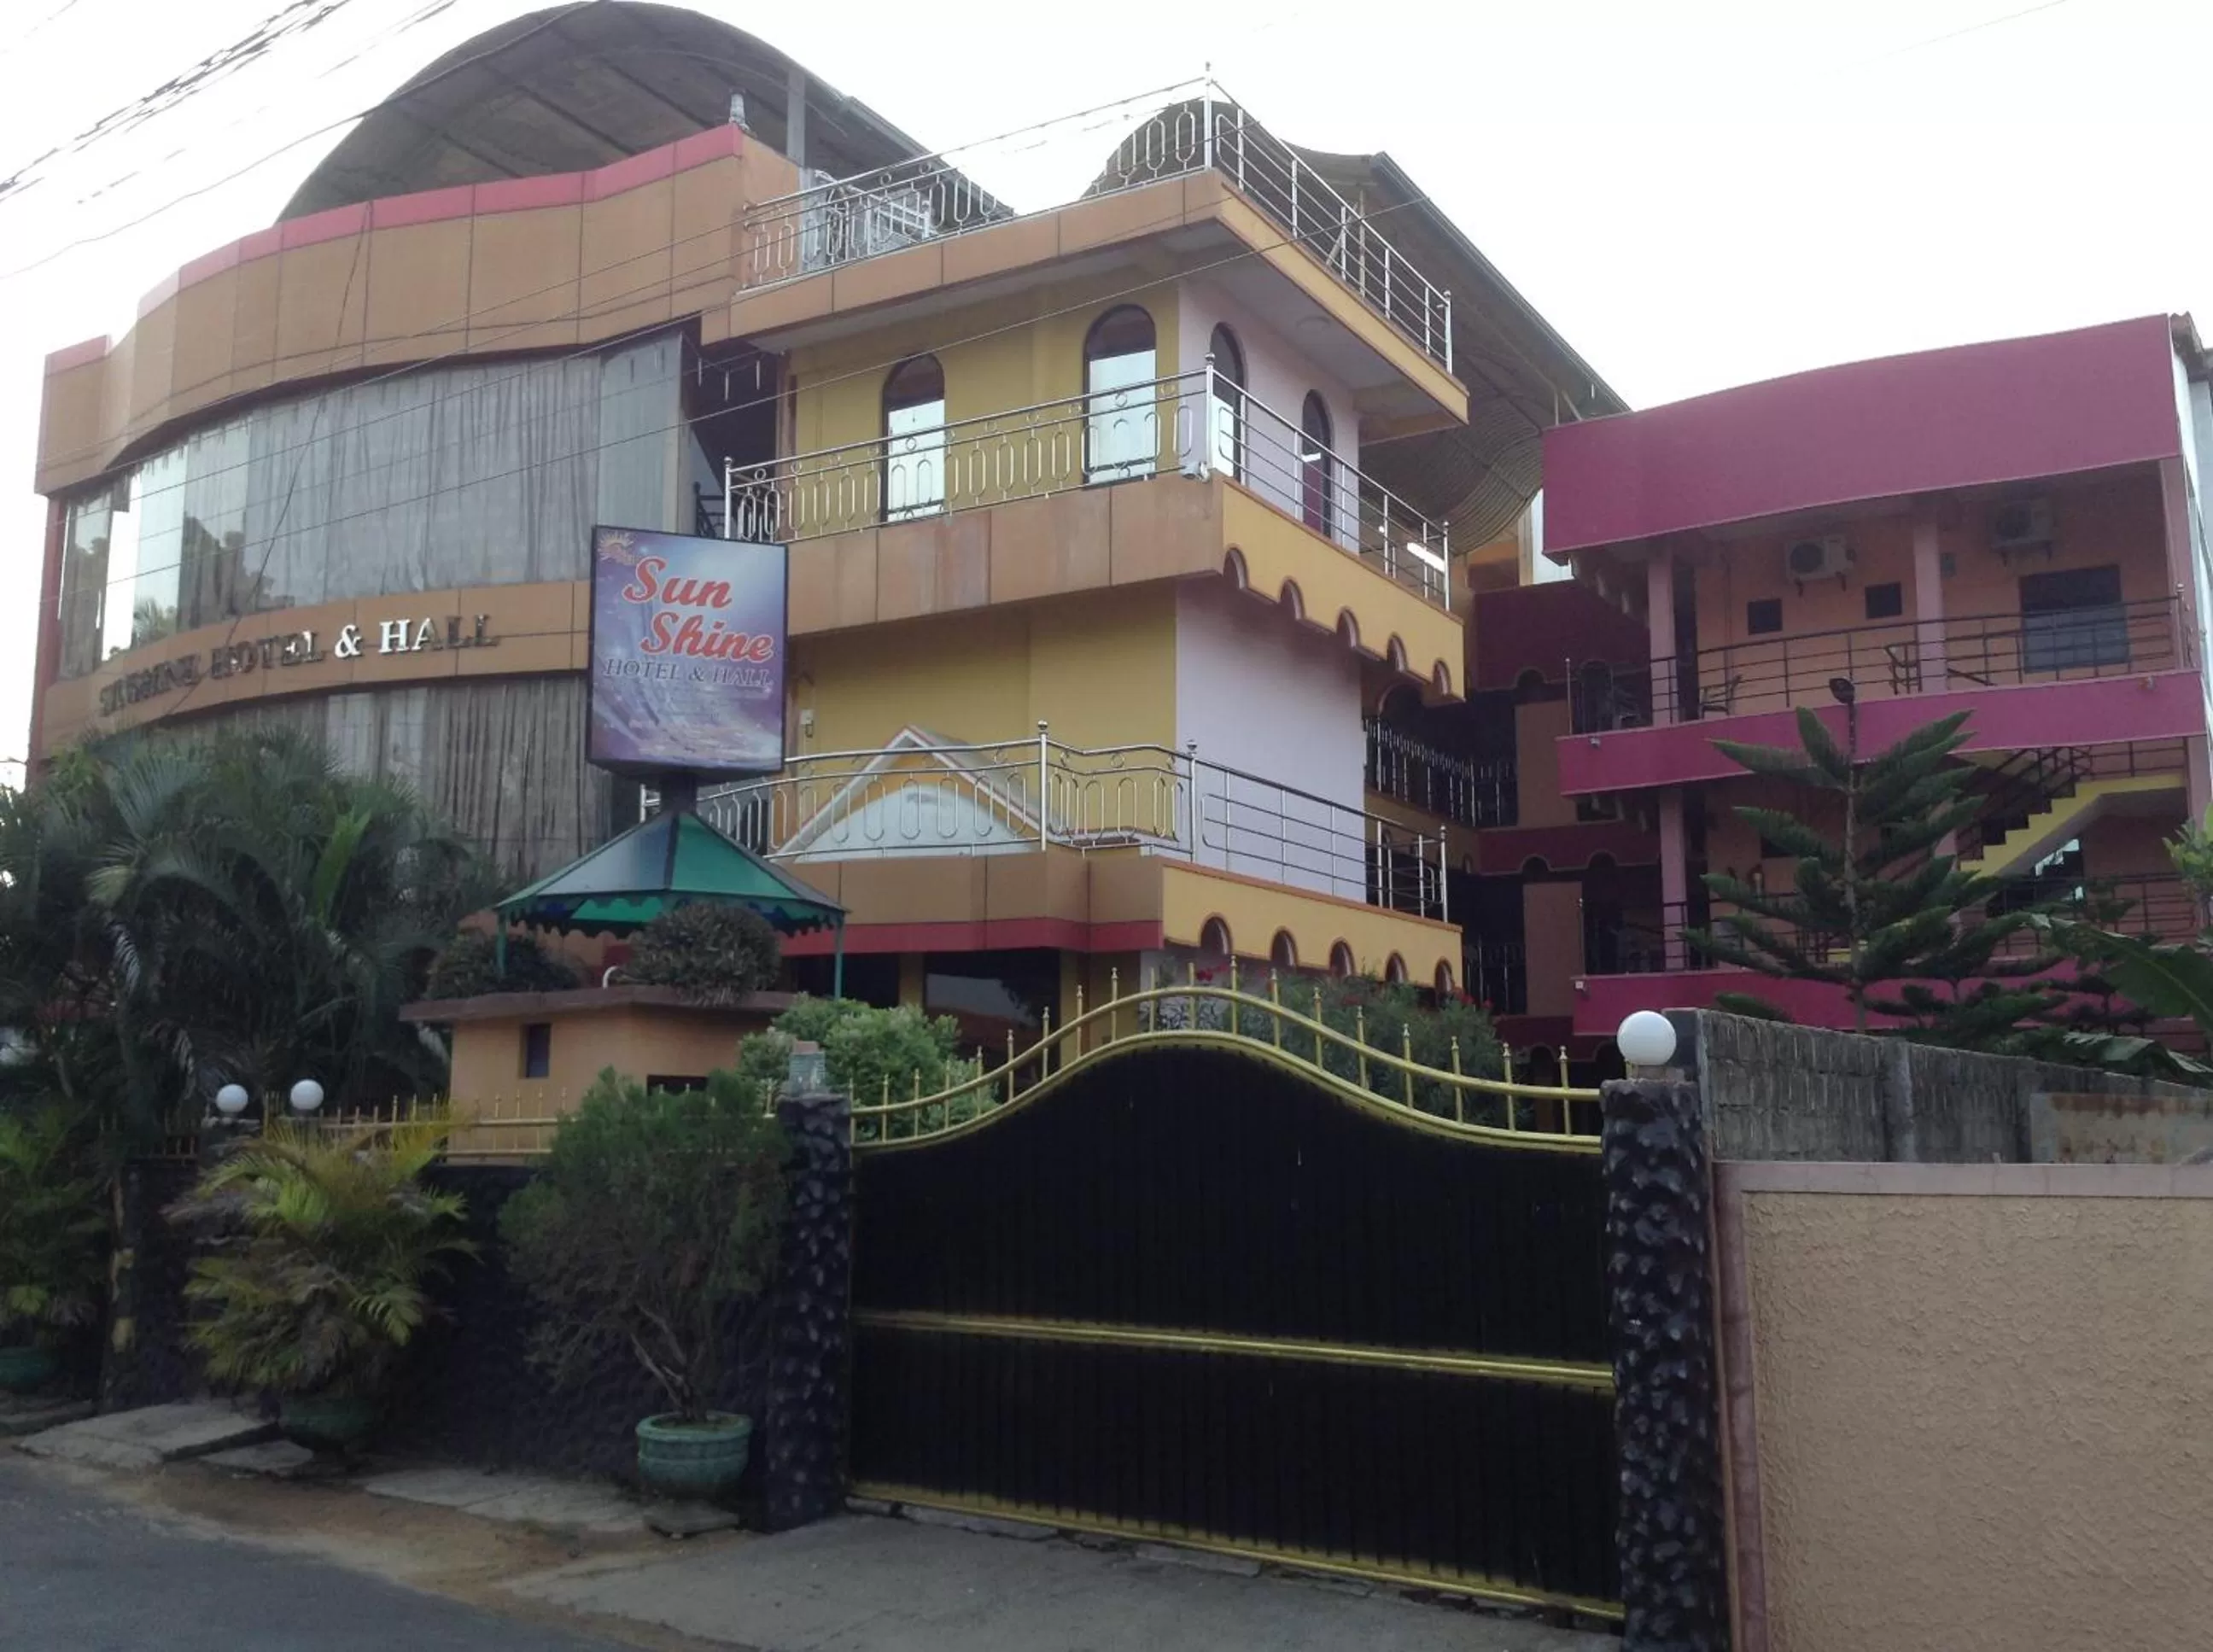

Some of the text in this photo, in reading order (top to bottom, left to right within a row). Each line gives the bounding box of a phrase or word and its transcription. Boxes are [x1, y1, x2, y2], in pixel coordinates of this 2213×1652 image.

[622, 556, 733, 609] Sun
[211, 630, 325, 680] HOTEL
[334, 624, 364, 659] &
[378, 612, 499, 655] HALL
[639, 610, 774, 663] Shine
[604, 658, 773, 688] HOTEL & HALL
